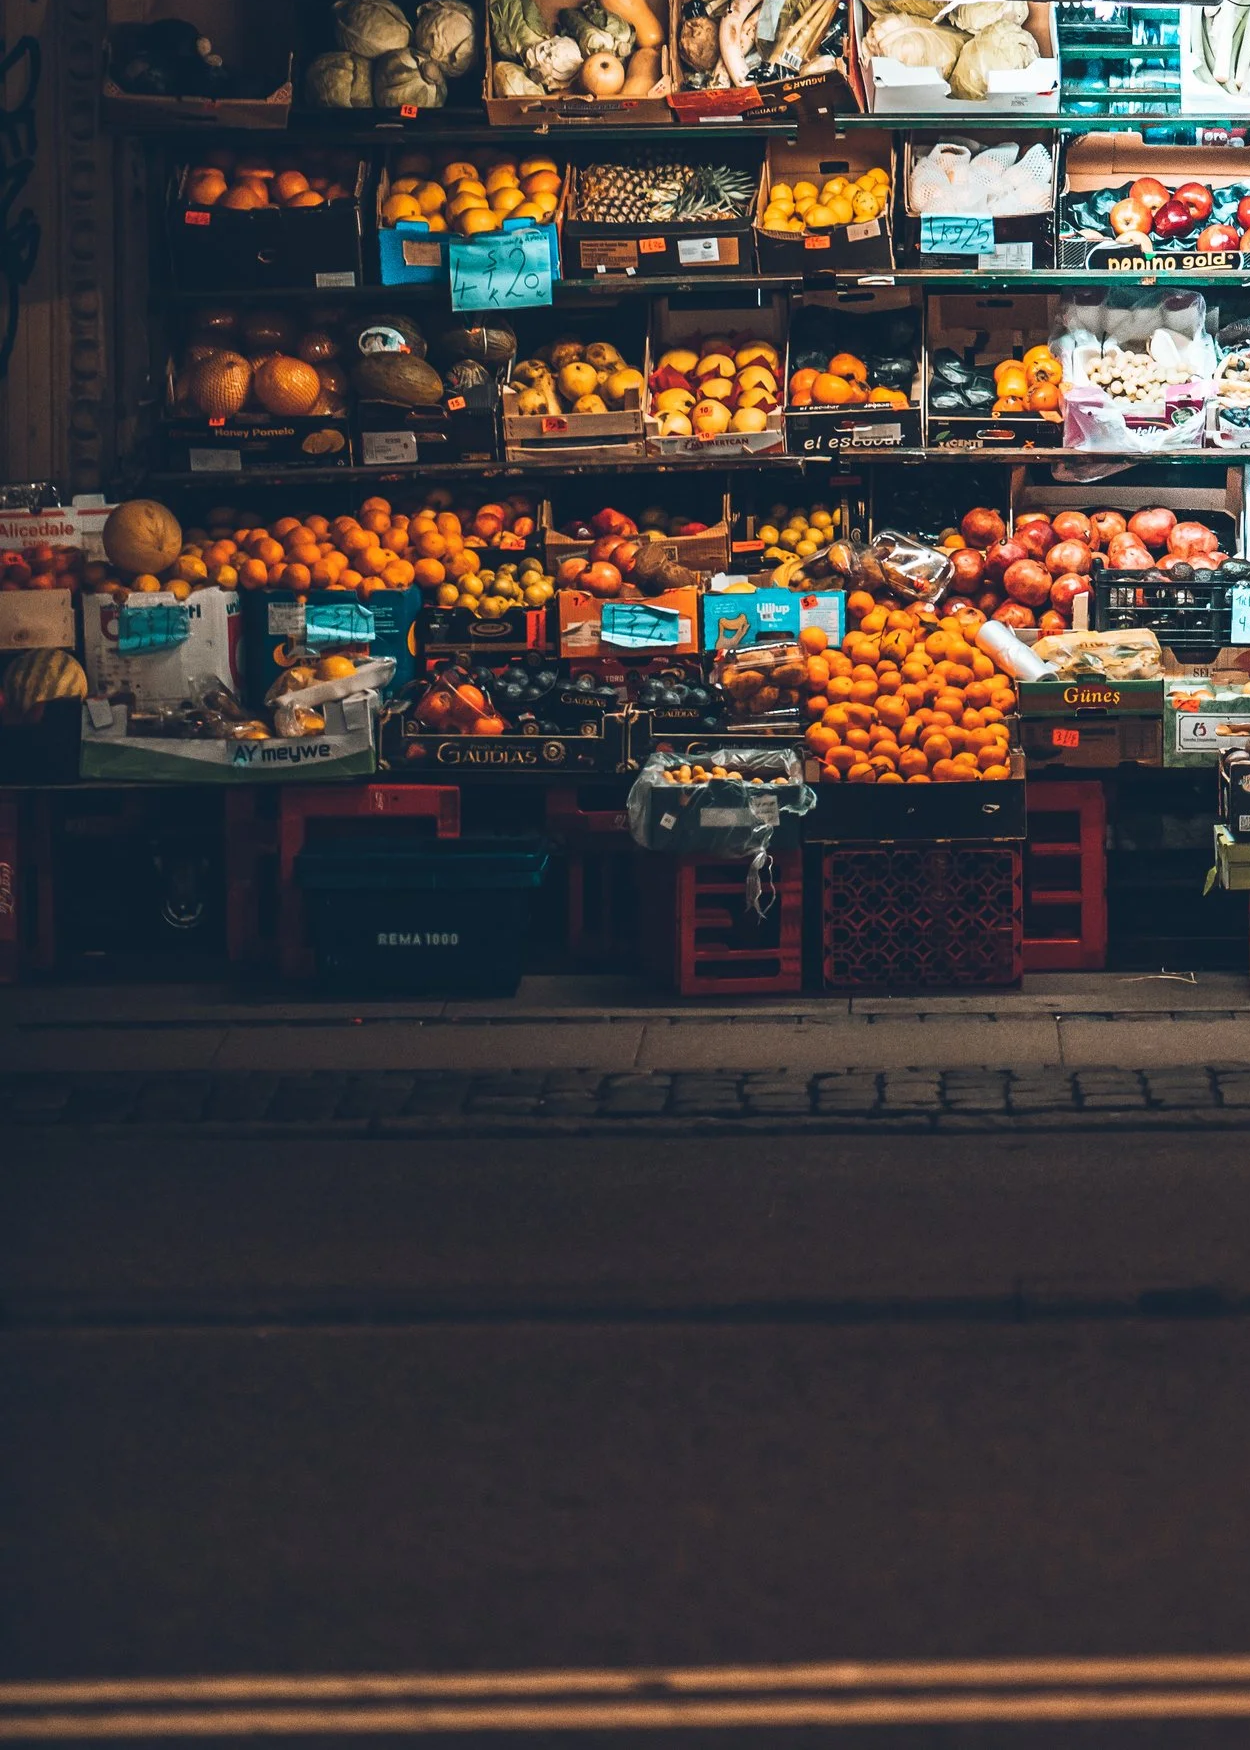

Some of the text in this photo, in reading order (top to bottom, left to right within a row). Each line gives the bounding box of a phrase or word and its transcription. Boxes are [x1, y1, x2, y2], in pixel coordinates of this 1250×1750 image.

[793, 75, 828, 91] JAGUAR
[1182, 252, 1226, 270] gold
[214, 426, 295, 439] Honey Pomelo
[707, 436, 749, 448] MERTCAN
[804, 435, 822, 451] el
[0, 522, 74, 537] Alicedale
[1063, 687, 1120, 705] Güneş
[261, 743, 331, 761] meywe
[377, 932, 459, 946] REMA 1000
